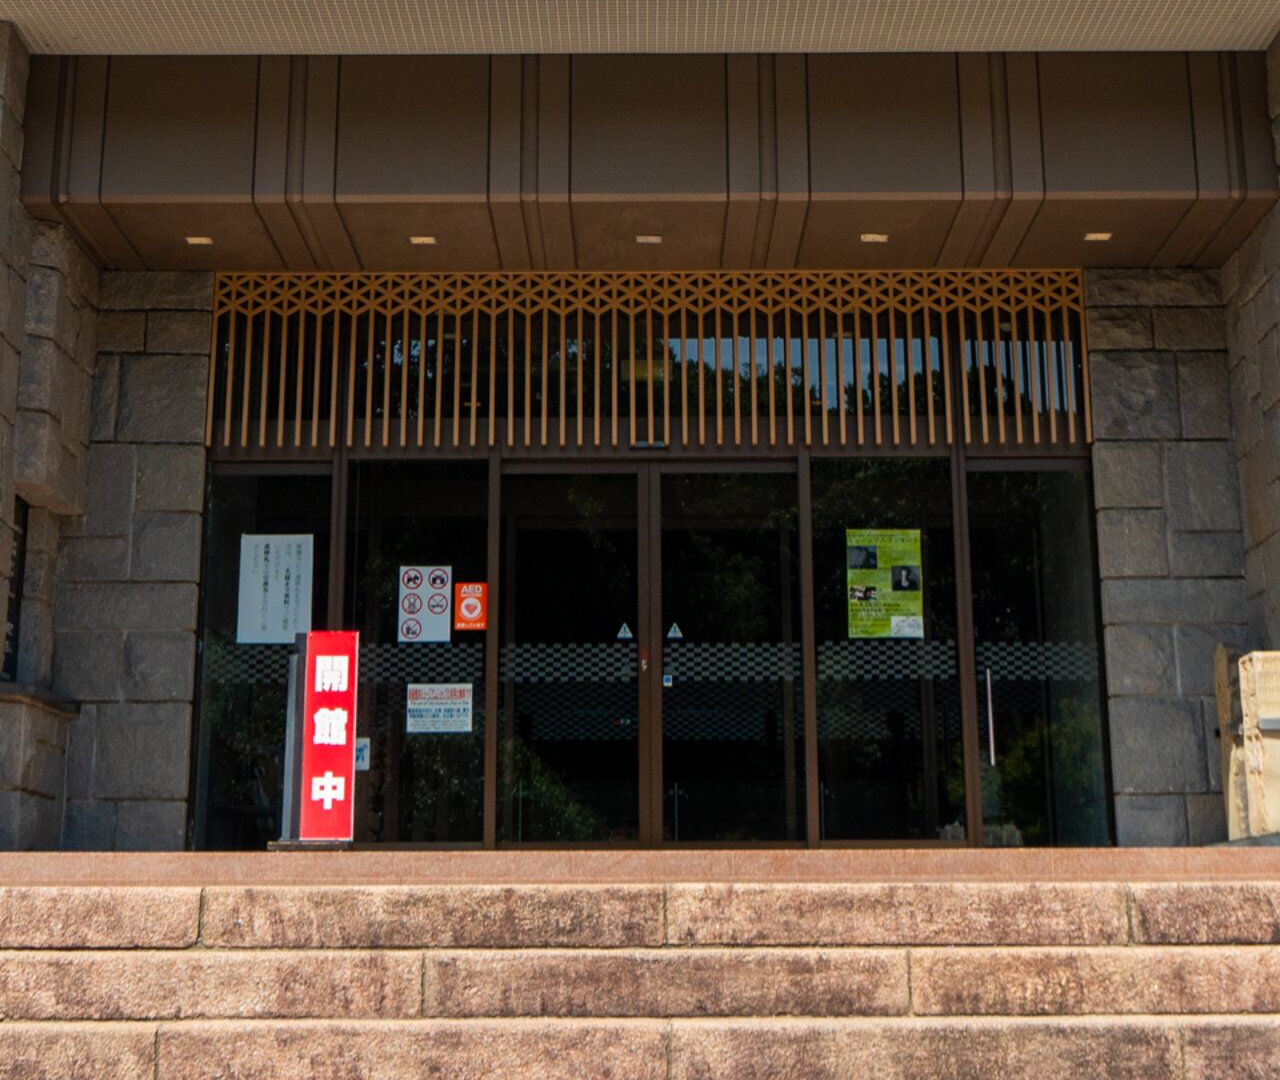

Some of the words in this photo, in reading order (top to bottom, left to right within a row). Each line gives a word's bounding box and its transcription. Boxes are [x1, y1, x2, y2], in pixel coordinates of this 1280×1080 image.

[461, 585, 482, 594] AED
[311, 655, 349, 810] 開館中
